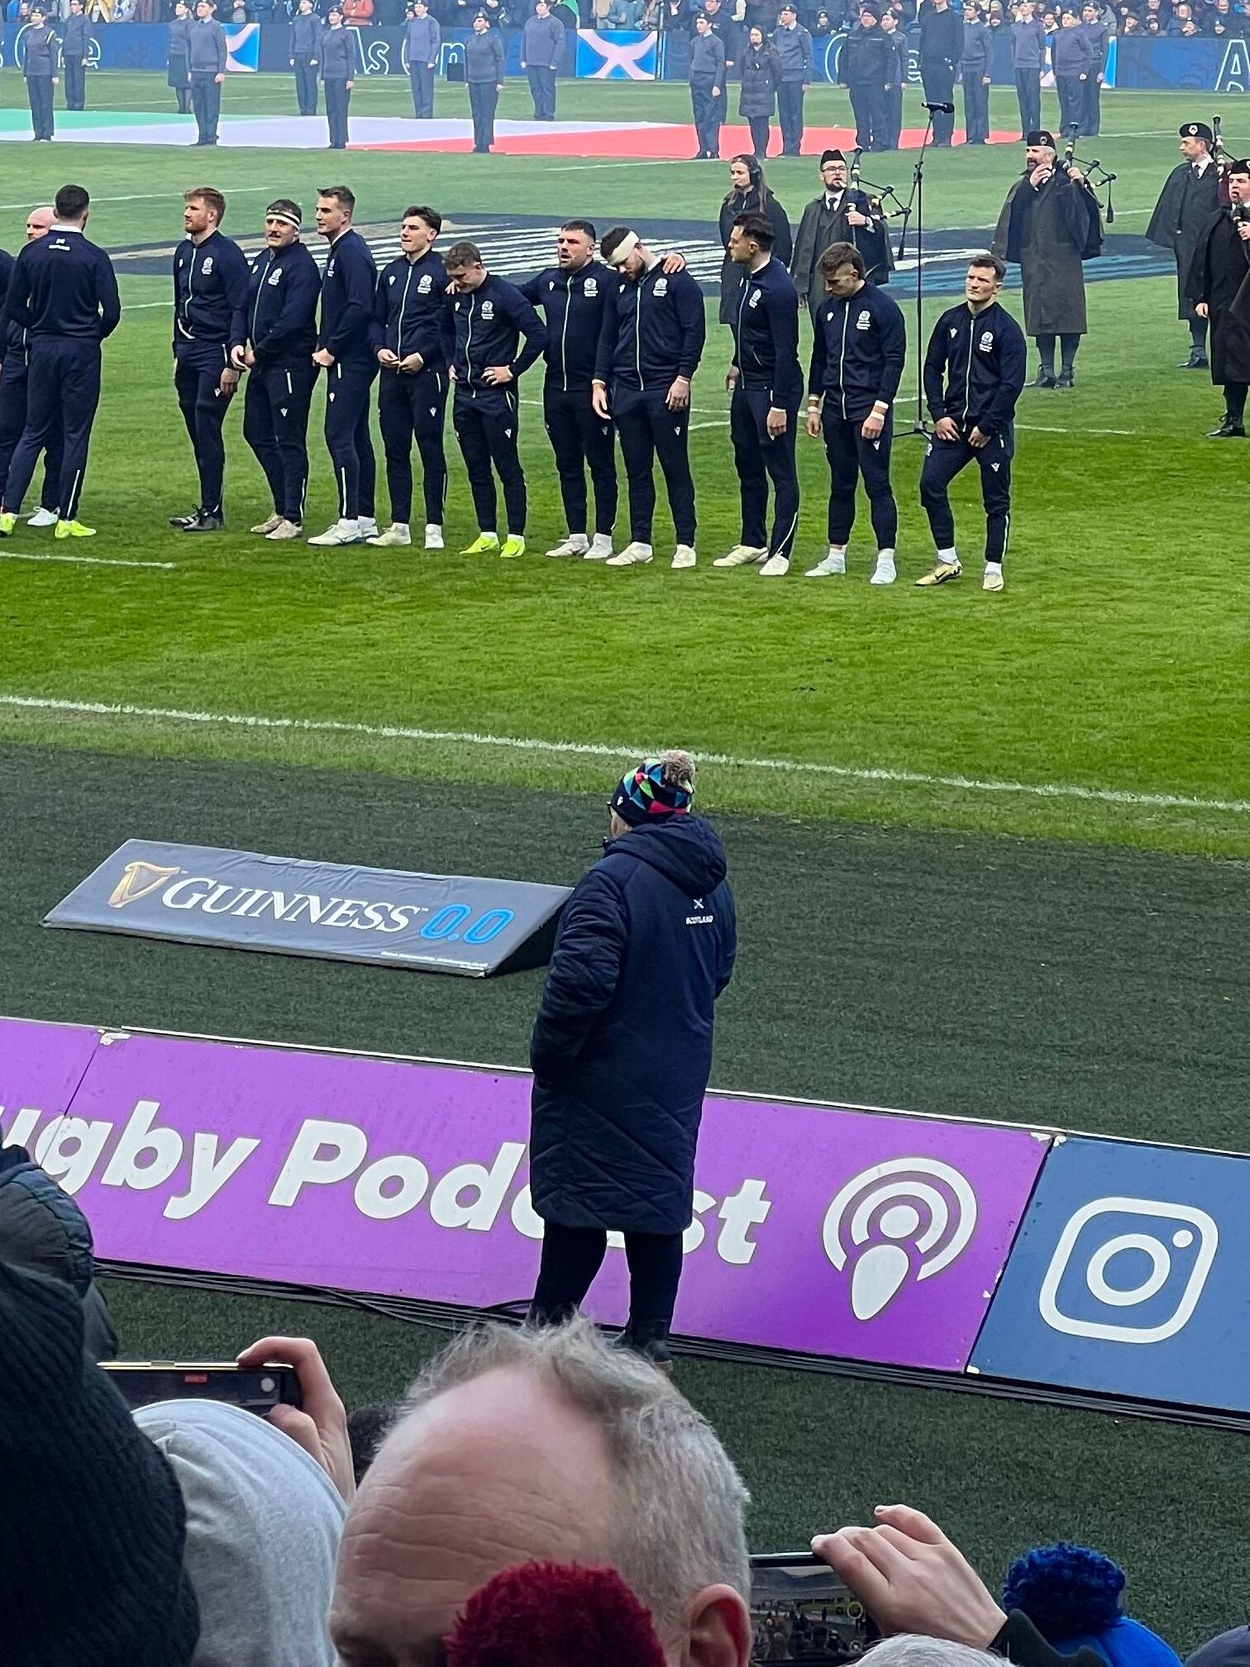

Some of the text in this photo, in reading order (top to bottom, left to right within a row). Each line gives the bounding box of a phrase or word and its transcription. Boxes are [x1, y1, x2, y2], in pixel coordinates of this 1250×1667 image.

[161, 877, 515, 945] GUINNESS 0.0
[266, 1118, 773, 1265] Podcst
